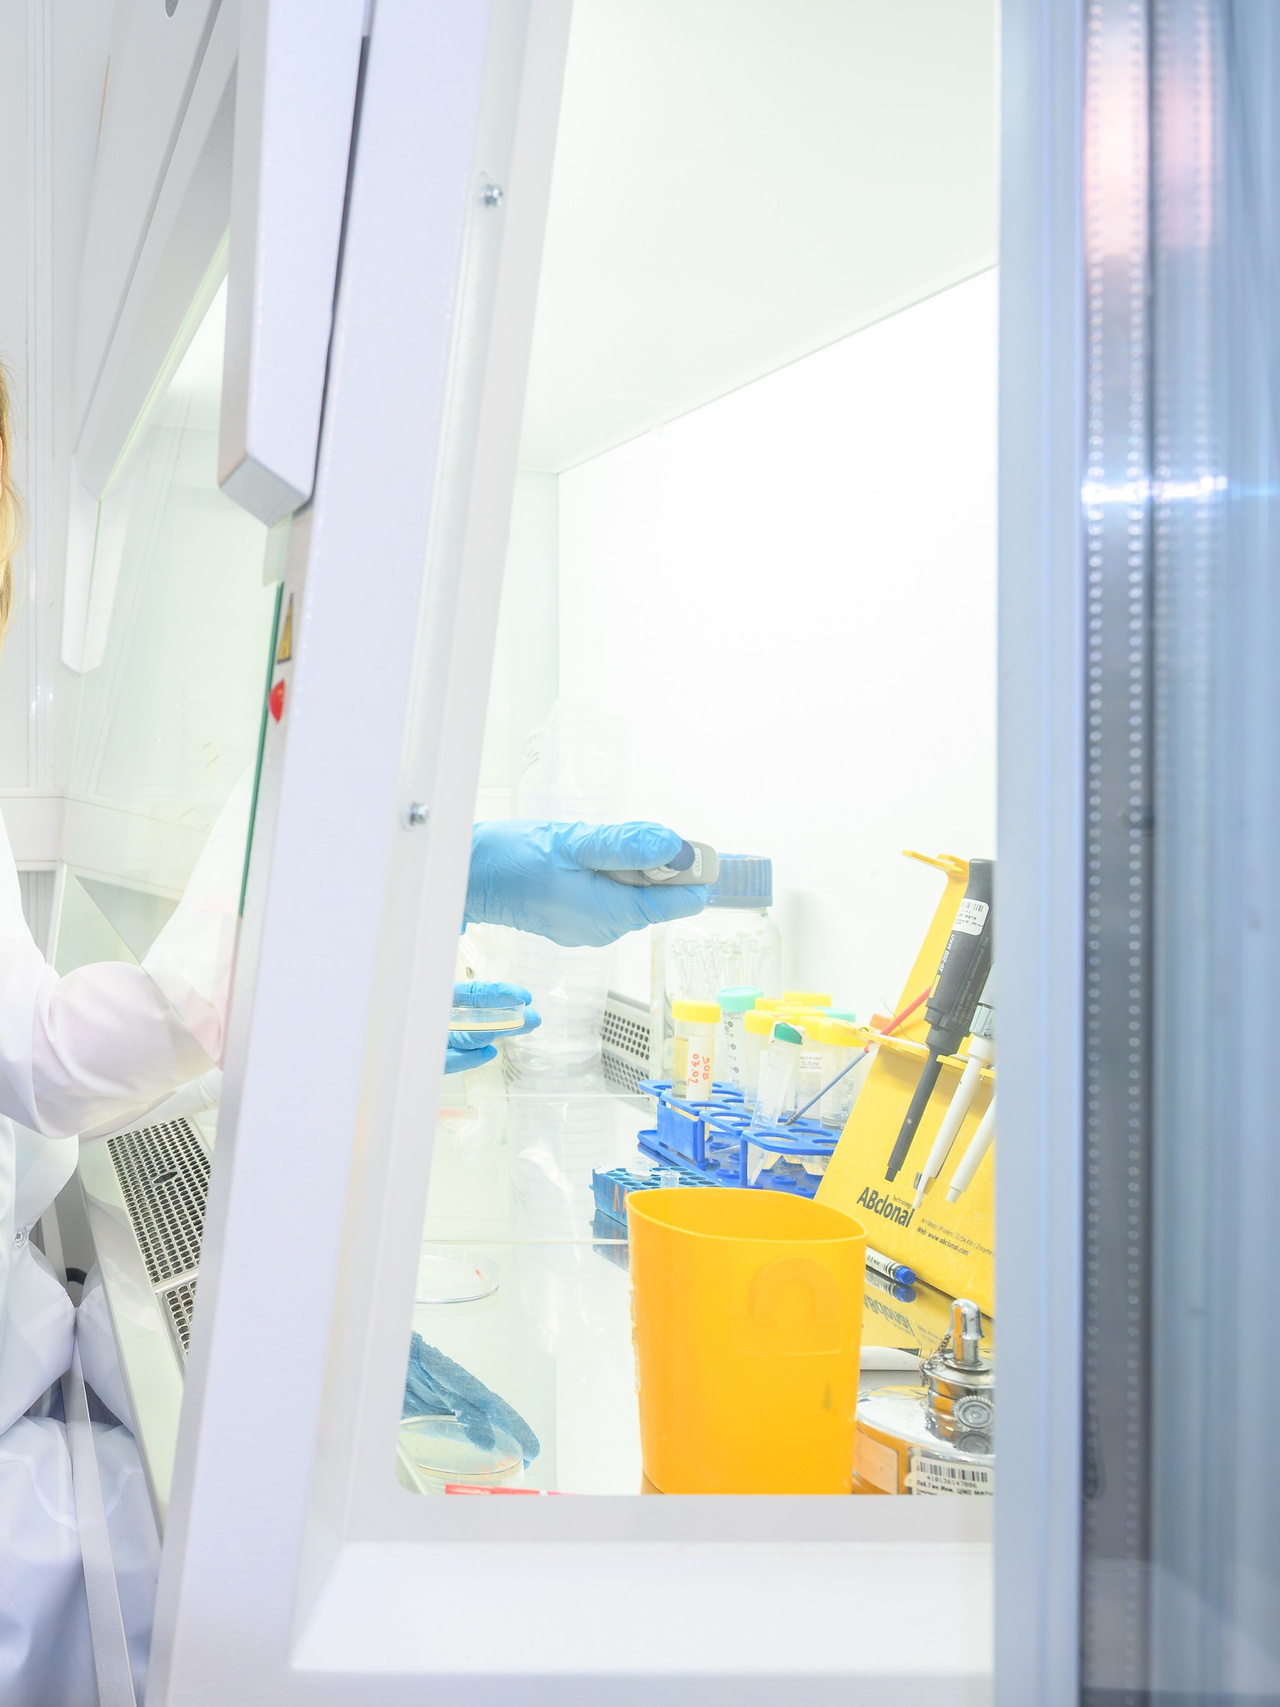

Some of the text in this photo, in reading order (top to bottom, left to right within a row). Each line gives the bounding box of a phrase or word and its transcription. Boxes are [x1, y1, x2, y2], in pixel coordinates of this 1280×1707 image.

[687, 1054, 700, 1086] 03.02
[856, 1186, 915, 1228] ABclonal
[893, 1195, 912, 1208] Technology
[927, 1231, 969, 1256] www.abclonal.com
